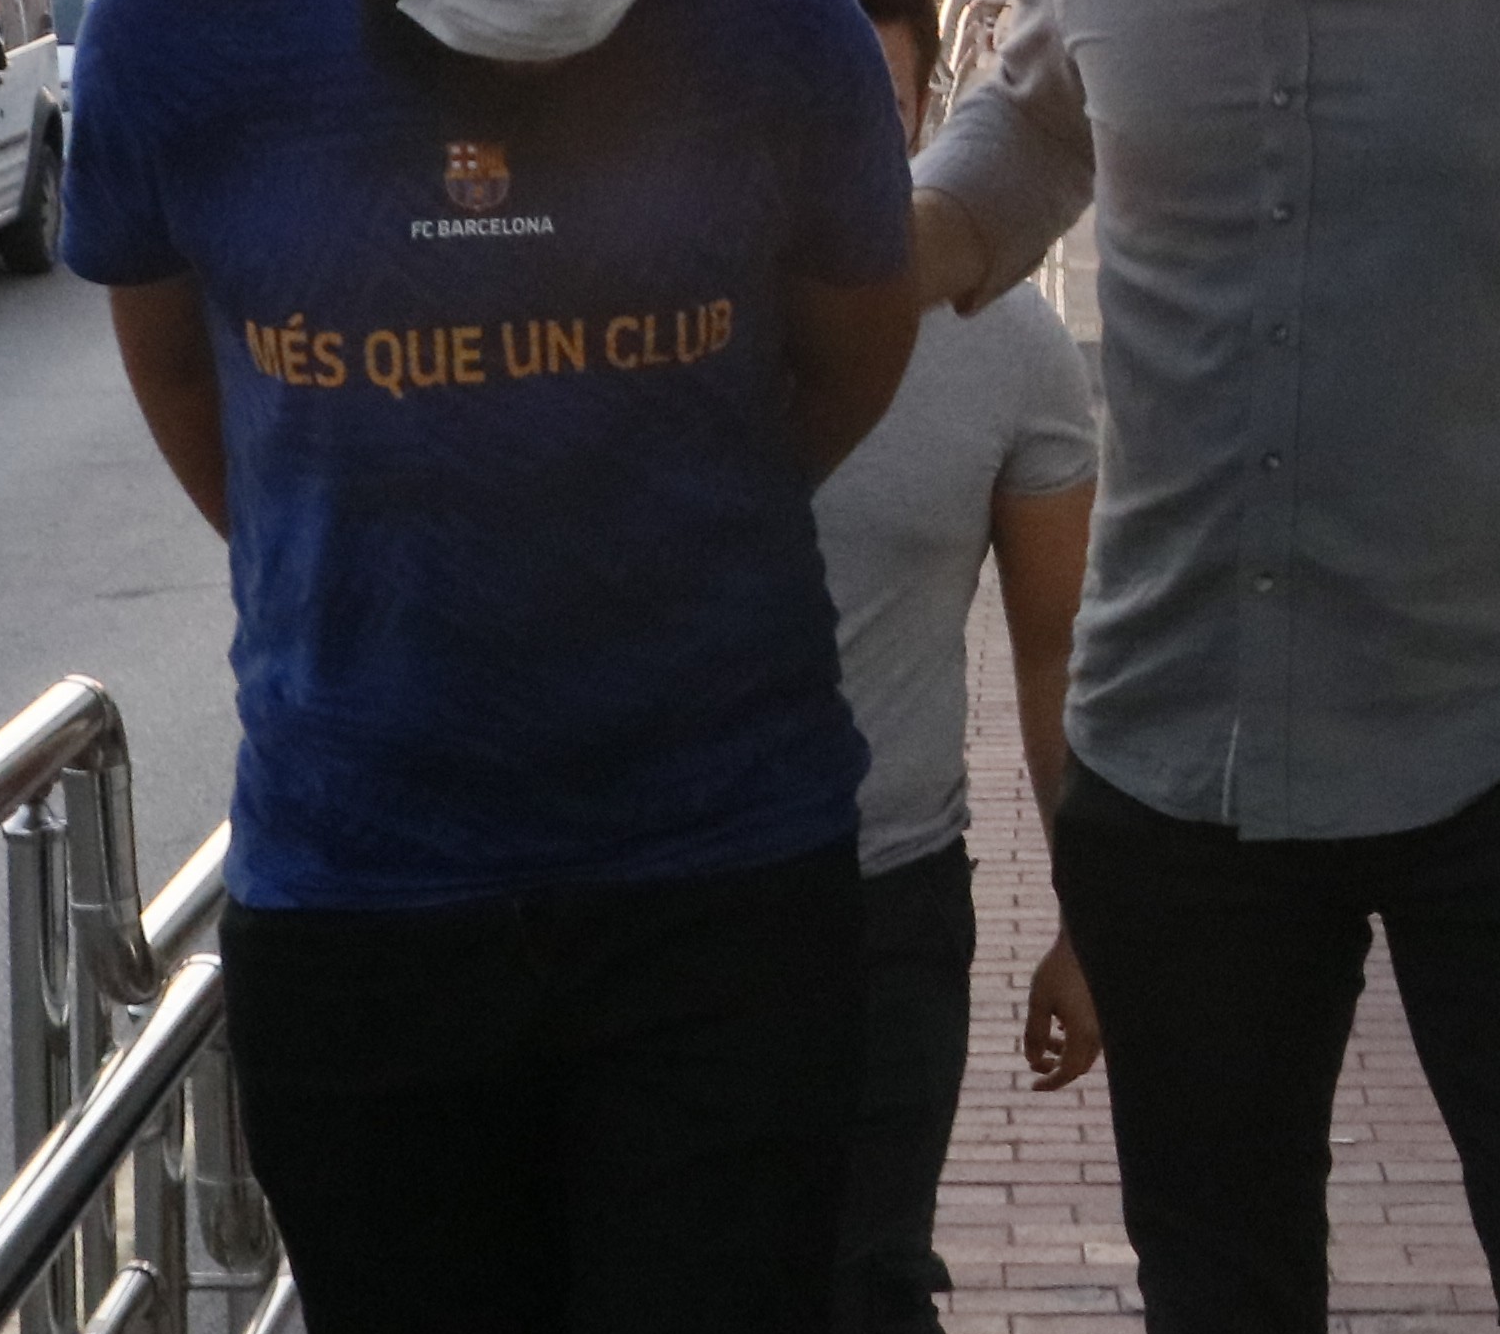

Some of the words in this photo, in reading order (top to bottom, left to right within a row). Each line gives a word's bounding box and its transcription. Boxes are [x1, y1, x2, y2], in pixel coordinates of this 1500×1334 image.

[411, 220, 433, 238] FC
[437, 217, 554, 238] BARCELONA
[246, 313, 347, 388] MÉS
[364, 326, 485, 399] QUE
[502, 318, 585, 378] UN
[605, 299, 733, 368] CLUB
